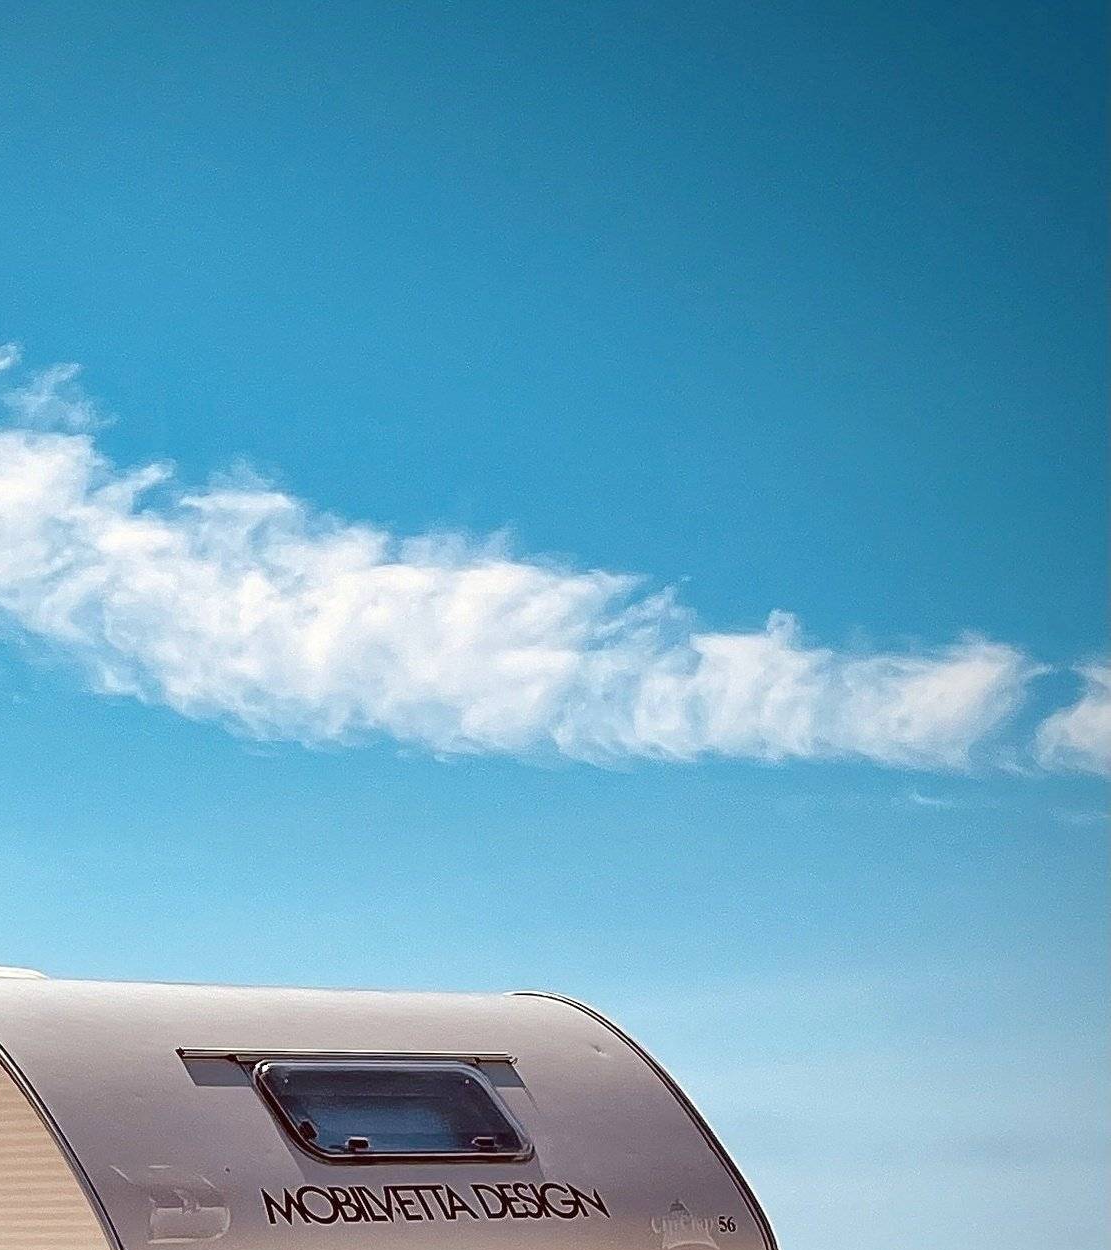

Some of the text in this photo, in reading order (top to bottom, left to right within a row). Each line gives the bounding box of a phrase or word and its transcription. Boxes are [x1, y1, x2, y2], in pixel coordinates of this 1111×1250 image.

[261, 1183, 611, 1225] MOBILVETTA DESIGN
[718, 1216, 737, 1233] 56
